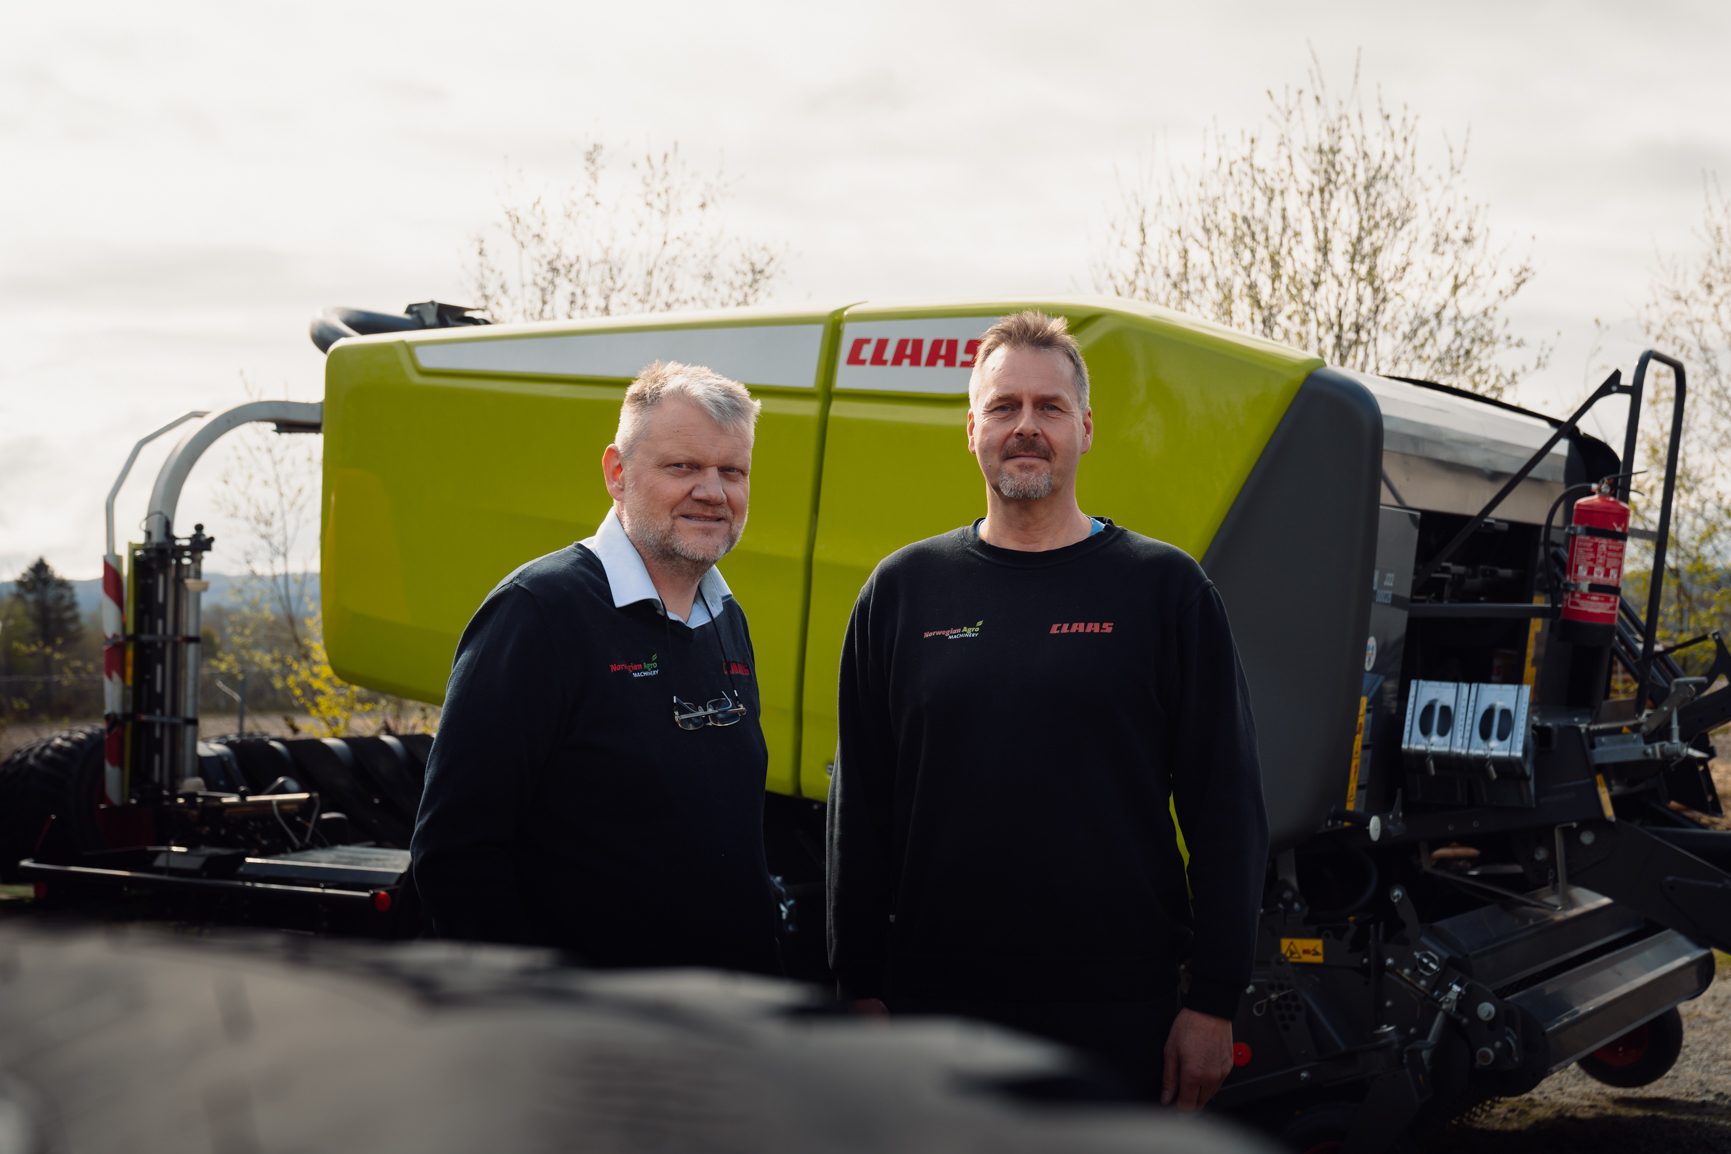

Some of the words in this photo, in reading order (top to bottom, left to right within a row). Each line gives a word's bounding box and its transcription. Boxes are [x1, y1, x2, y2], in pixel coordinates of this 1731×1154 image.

[846, 338, 981, 368] CLAAS
[923, 628, 961, 638] Norwegian
[961, 626, 980, 634] Agro
[1049, 622, 1115, 634] CLAAS
[947, 632, 979, 640] MACHINERY
